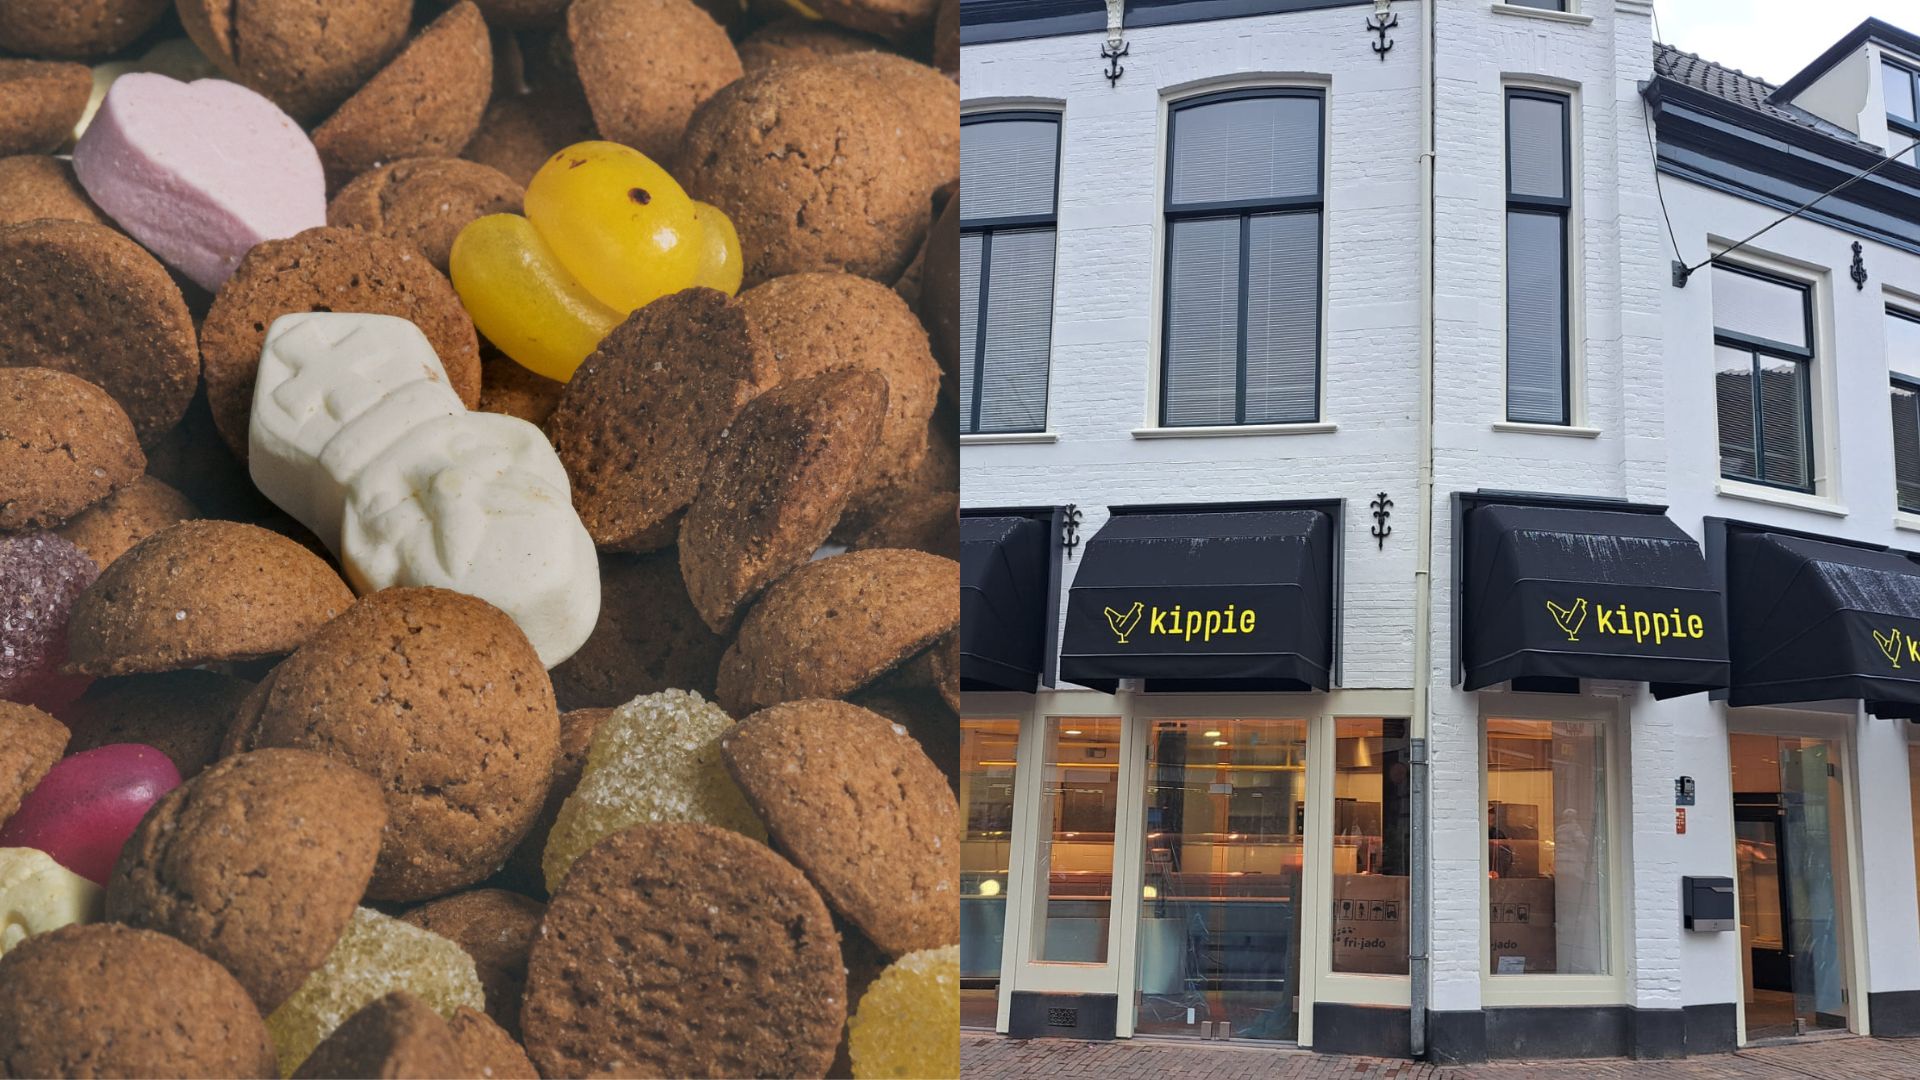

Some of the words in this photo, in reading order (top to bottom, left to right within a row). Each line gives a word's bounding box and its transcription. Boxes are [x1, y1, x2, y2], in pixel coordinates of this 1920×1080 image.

[1150, 604, 1256, 642] kippie
[1596, 604, 1704, 645] kippie
[1906, 635, 1920, 662] k
[1344, 937, 1386, 950] fri-jado
[1490, 939, 1518, 951] -jado
